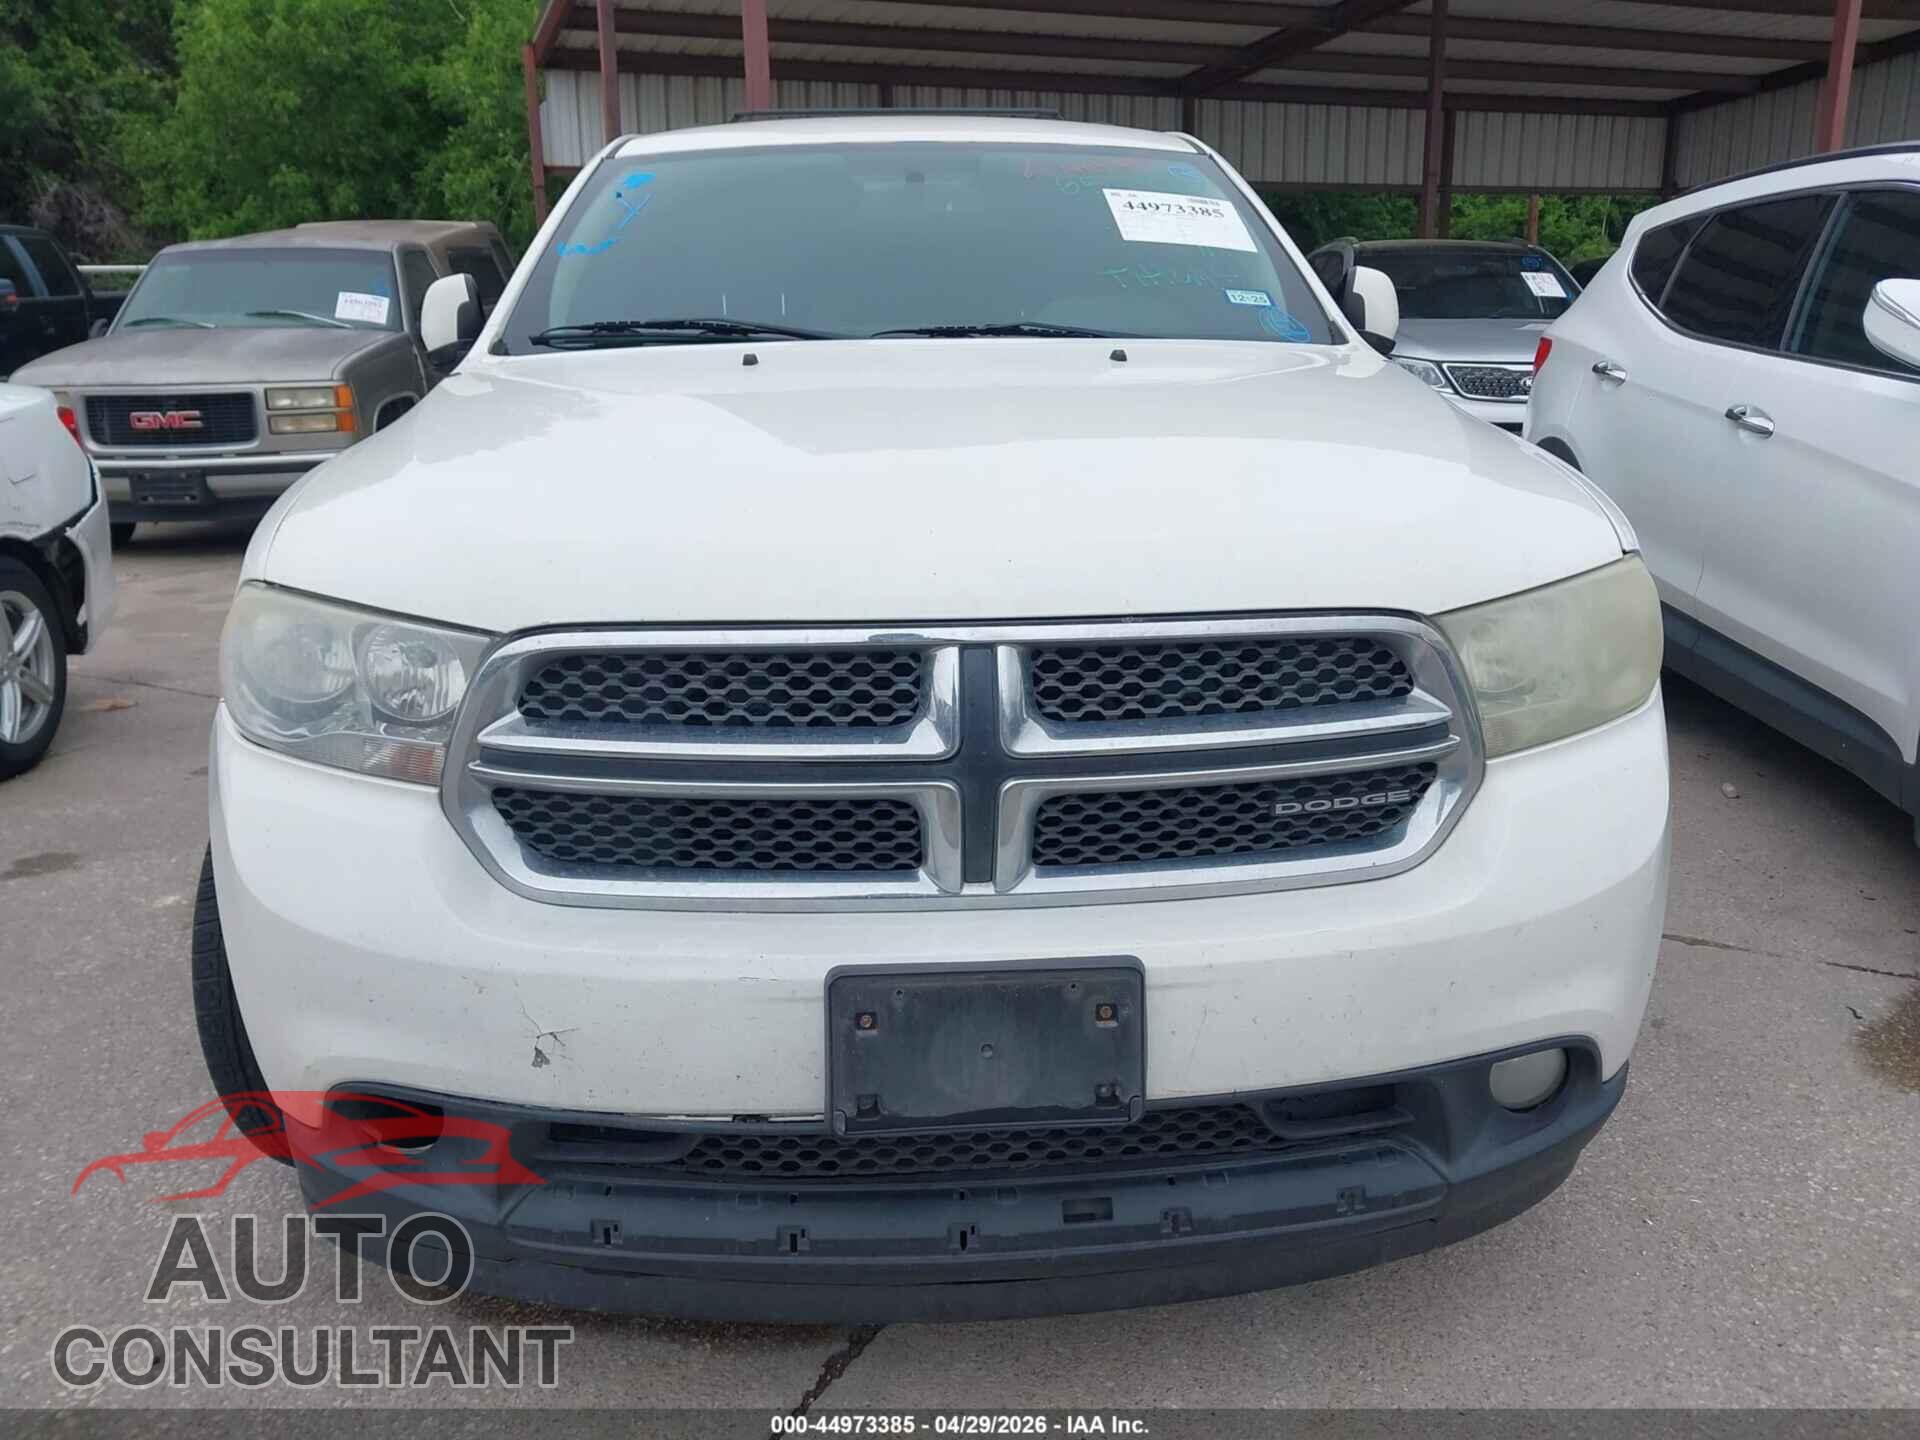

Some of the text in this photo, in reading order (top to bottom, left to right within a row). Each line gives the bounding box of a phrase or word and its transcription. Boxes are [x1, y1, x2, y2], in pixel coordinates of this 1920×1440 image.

[1122, 200, 1225, 219] 44973385
[129, 410, 203, 429] GMC
[1274, 789, 1411, 815] DODGE
